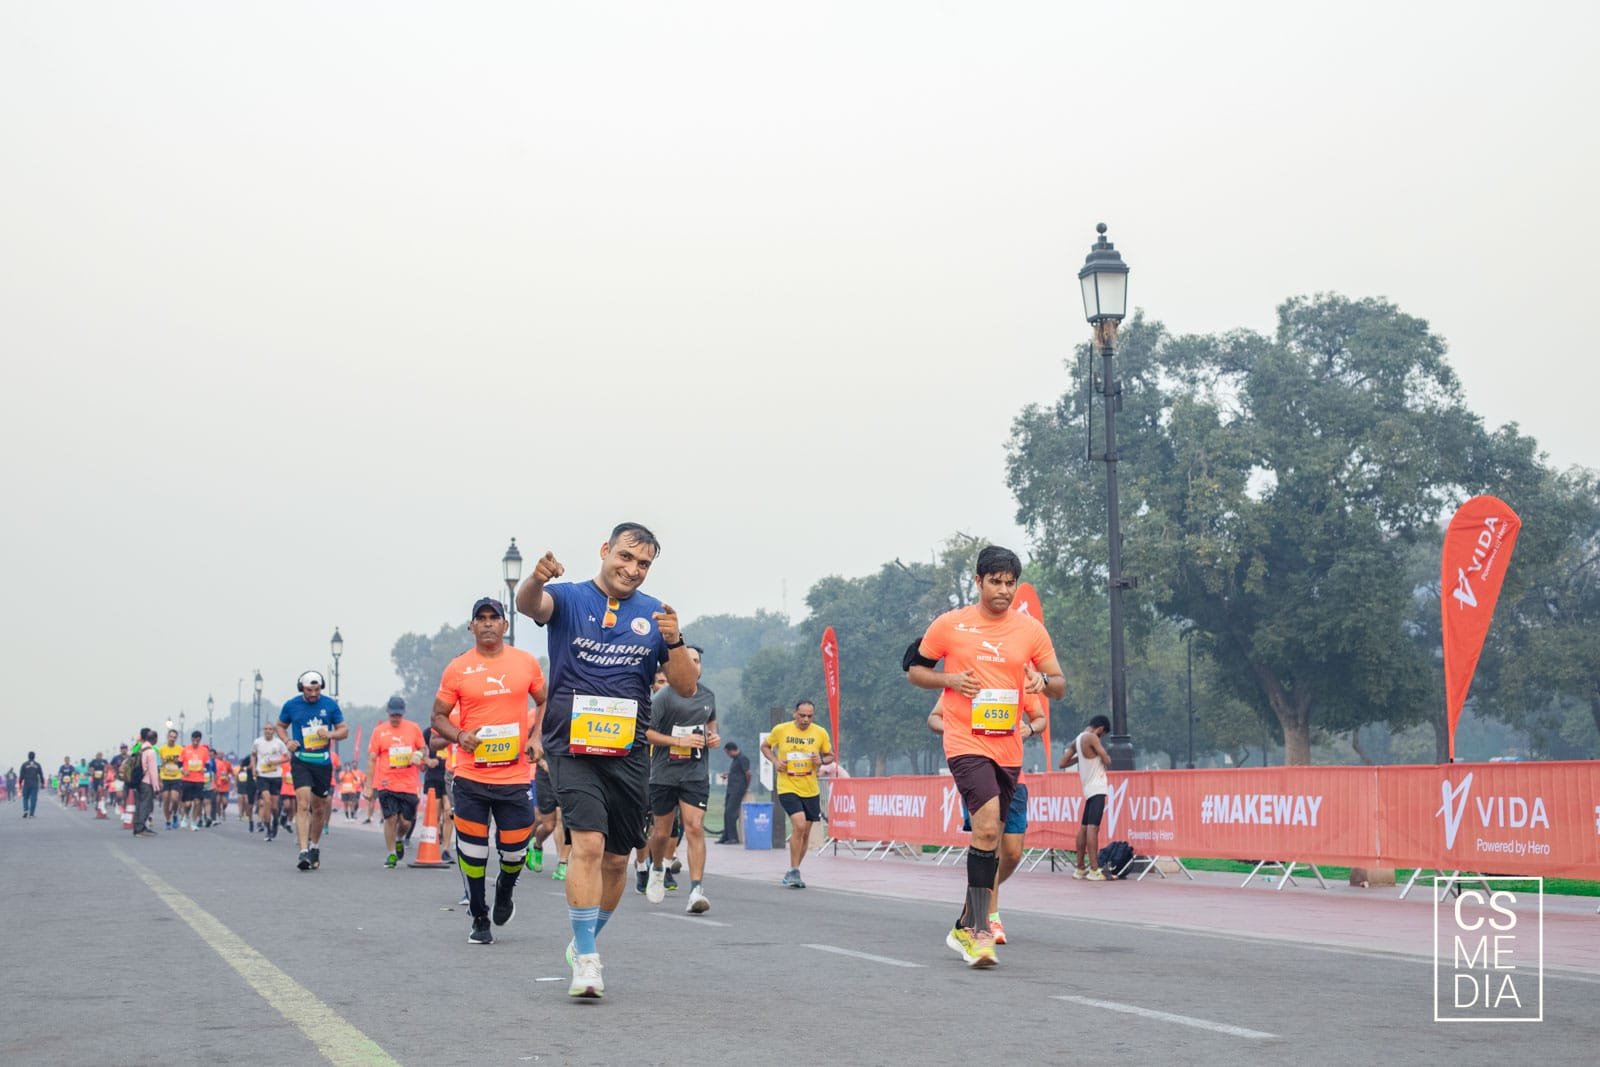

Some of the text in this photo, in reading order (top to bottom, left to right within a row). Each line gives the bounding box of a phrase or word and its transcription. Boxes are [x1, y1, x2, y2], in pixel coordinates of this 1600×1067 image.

[1467, 517, 1499, 571] VIDA
[572, 636, 652, 656] KHATARNAK
[577, 651, 643, 666] RUNNERS
[984, 708, 1009, 719] 6536
[587, 720, 621, 735] 1442
[485, 742, 511, 753] 7209
[786, 736, 805, 745] SHOW
[833, 794, 857, 814] VIDA
[868, 794, 927, 818] #MAKEWAY
[1026, 796, 1082, 823] AKEWAY
[1128, 796, 1175, 822] VIDA
[1201, 794, 1323, 827] #MAKEWAY
[1476, 796, 1550, 829] VIDA
[1476, 838, 1551, 857] Powered by Hero
